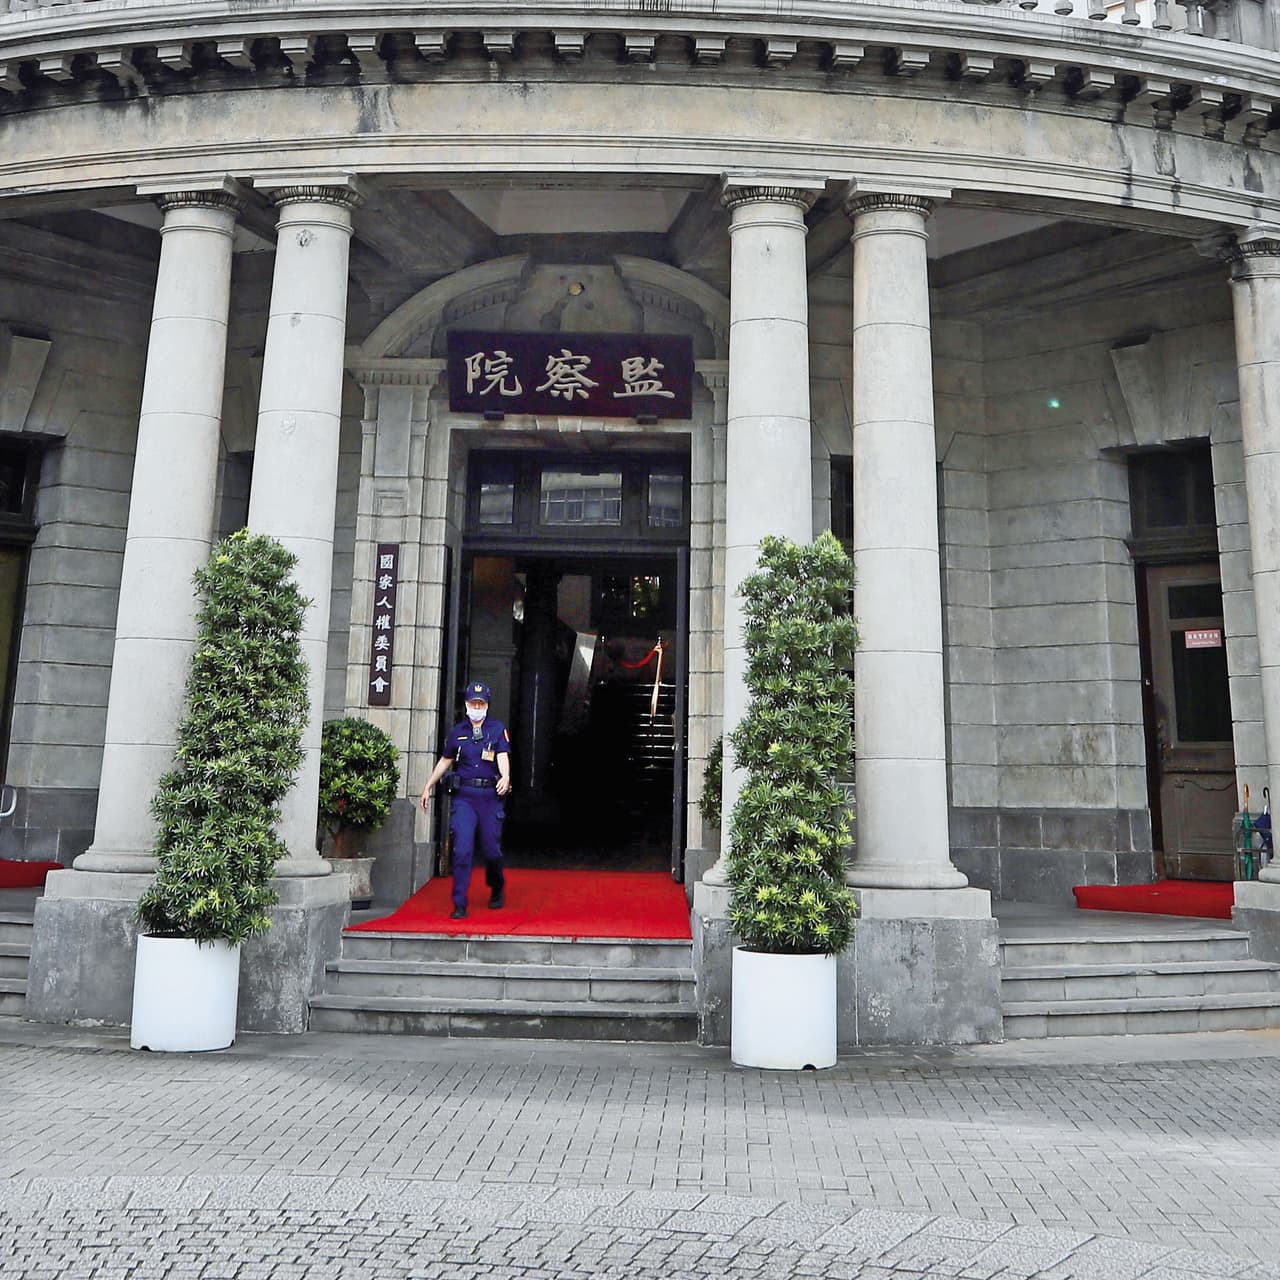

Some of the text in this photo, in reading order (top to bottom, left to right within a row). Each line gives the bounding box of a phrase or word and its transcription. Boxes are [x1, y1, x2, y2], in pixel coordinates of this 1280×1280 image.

[370, 554, 395, 693] 國家人權委員會
